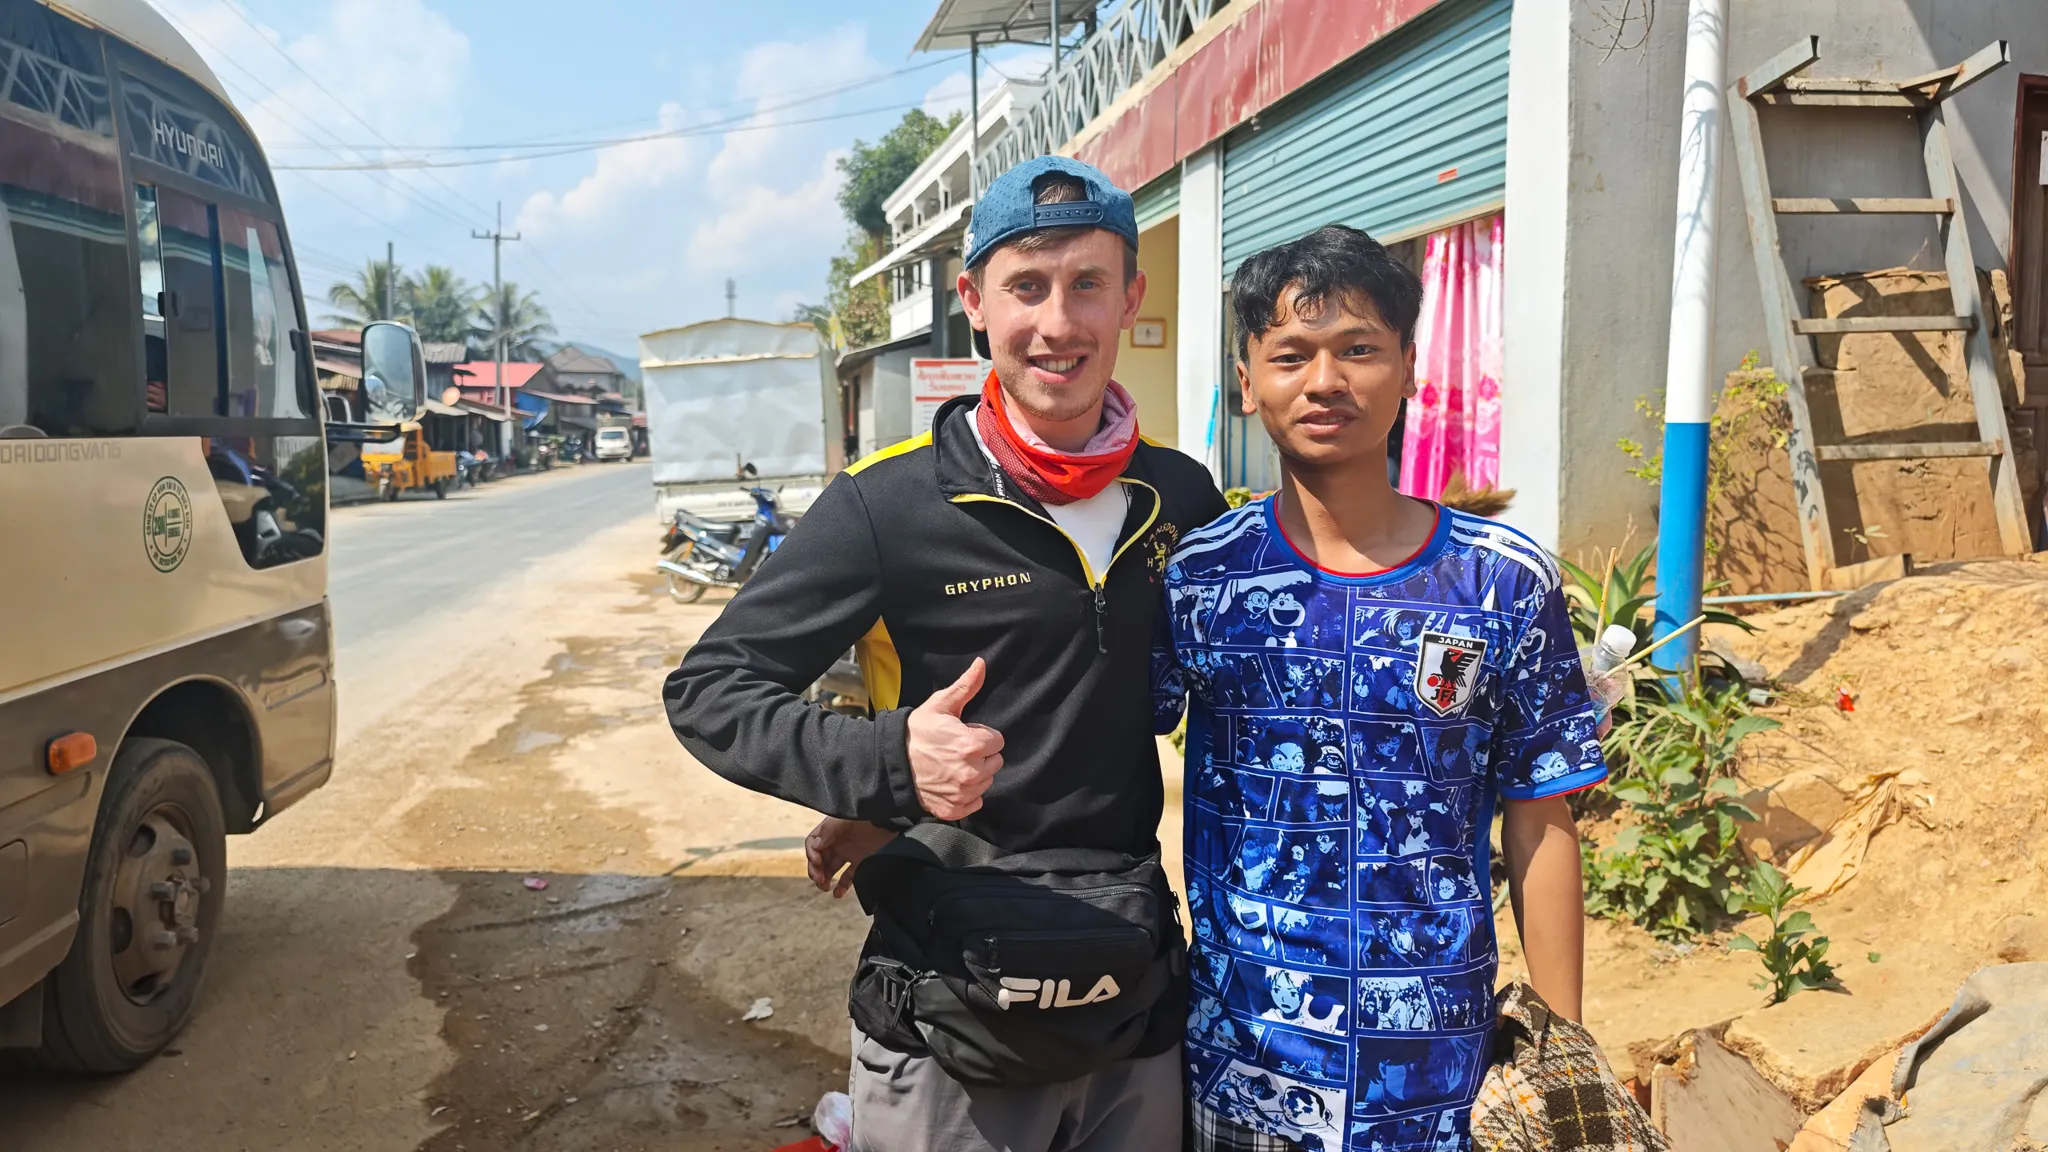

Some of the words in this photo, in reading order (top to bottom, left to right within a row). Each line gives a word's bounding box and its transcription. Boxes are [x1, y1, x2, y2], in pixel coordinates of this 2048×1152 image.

[152, 118, 224, 169] HYUNDAI
[944, 572, 1032, 596] GRYPHON
[1438, 637, 1474, 649] JAPAN
[1430, 688, 1458, 703] JFA
[997, 974, 1121, 1011] FILA
